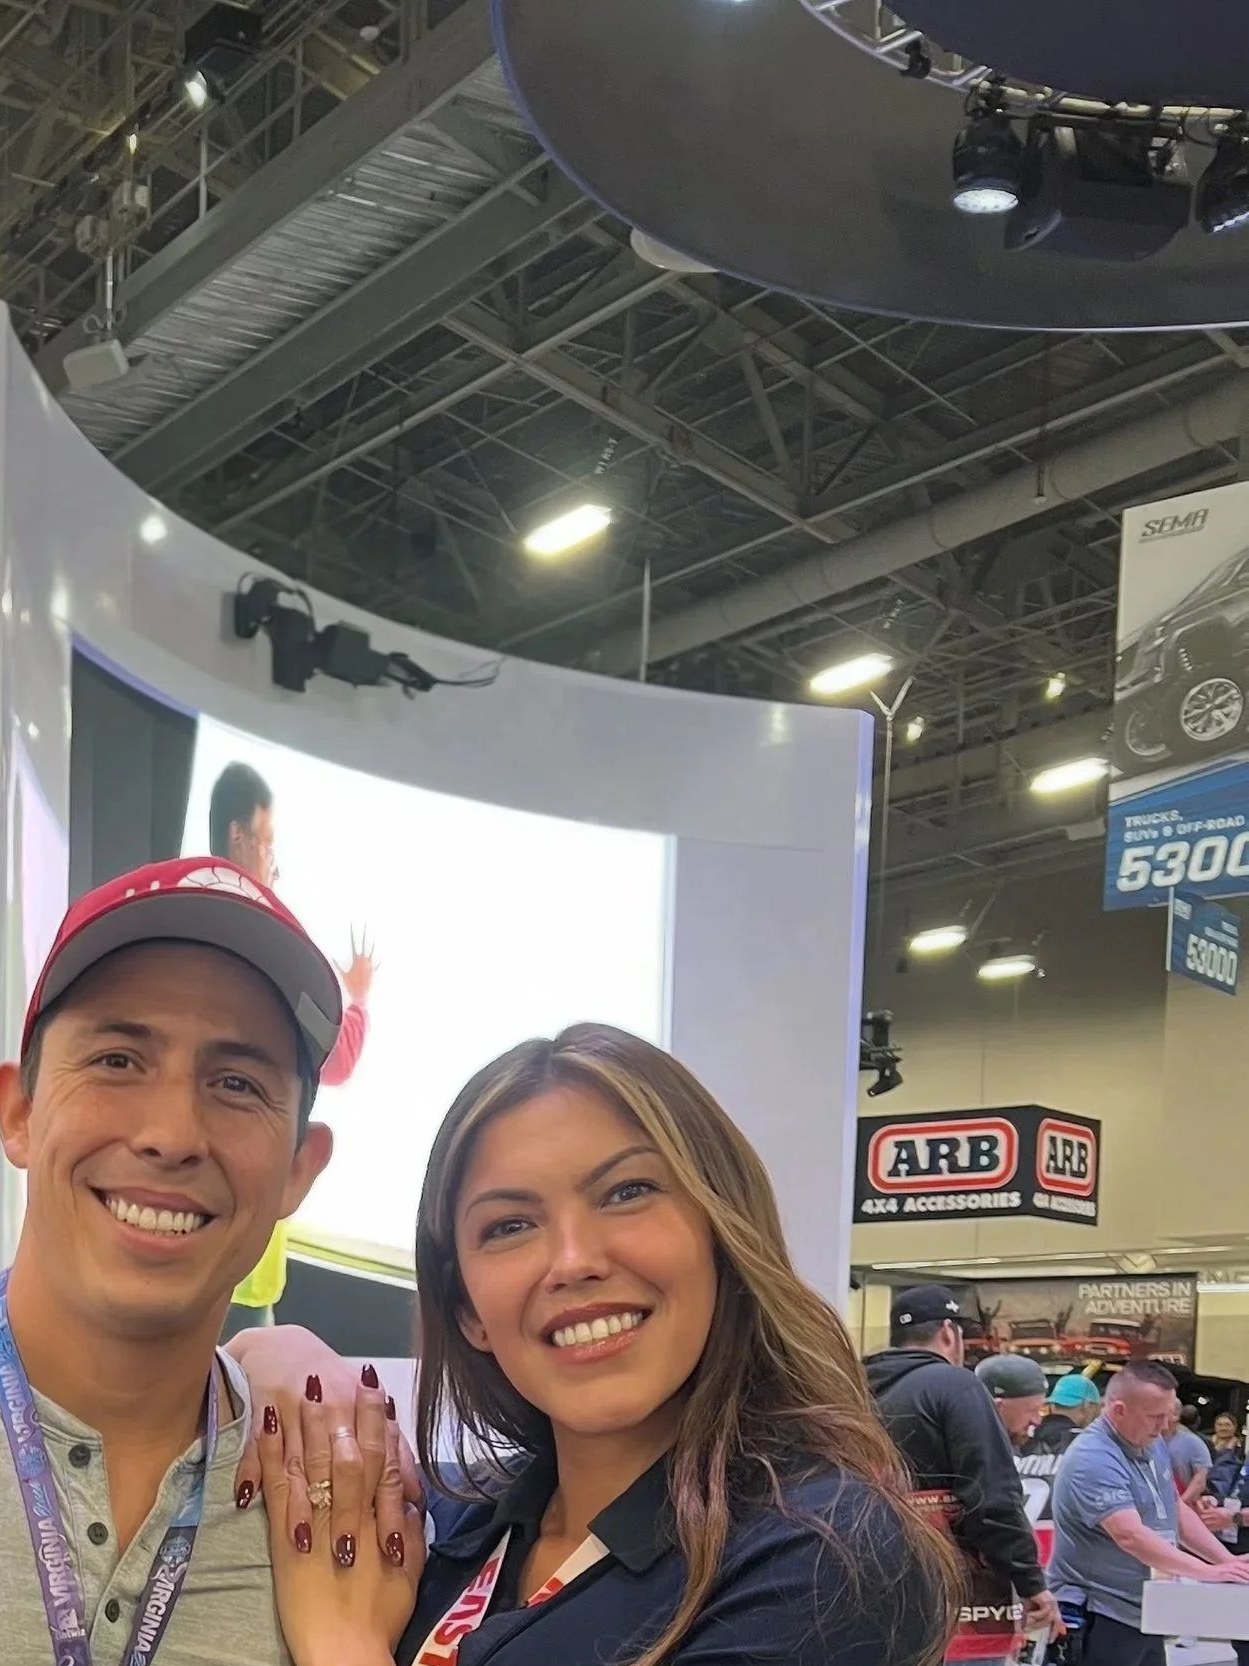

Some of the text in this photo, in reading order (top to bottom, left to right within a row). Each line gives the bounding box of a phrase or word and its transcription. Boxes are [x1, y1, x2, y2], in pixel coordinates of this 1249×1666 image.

[1141, 508, 1209, 537] SEMA
[1124, 809, 1184, 828] TRUCKS,
[1176, 815, 1245, 835] OFF-ROAD
[1186, 932, 1238, 986] 53000
[887, 1134, 1088, 1179] ARB ARB
[903, 1191, 1022, 1212] ACCESSORIES
[1078, 1281, 1191, 1299] PARTNERS IN
[1085, 1298, 1191, 1316] ADVENTURE
